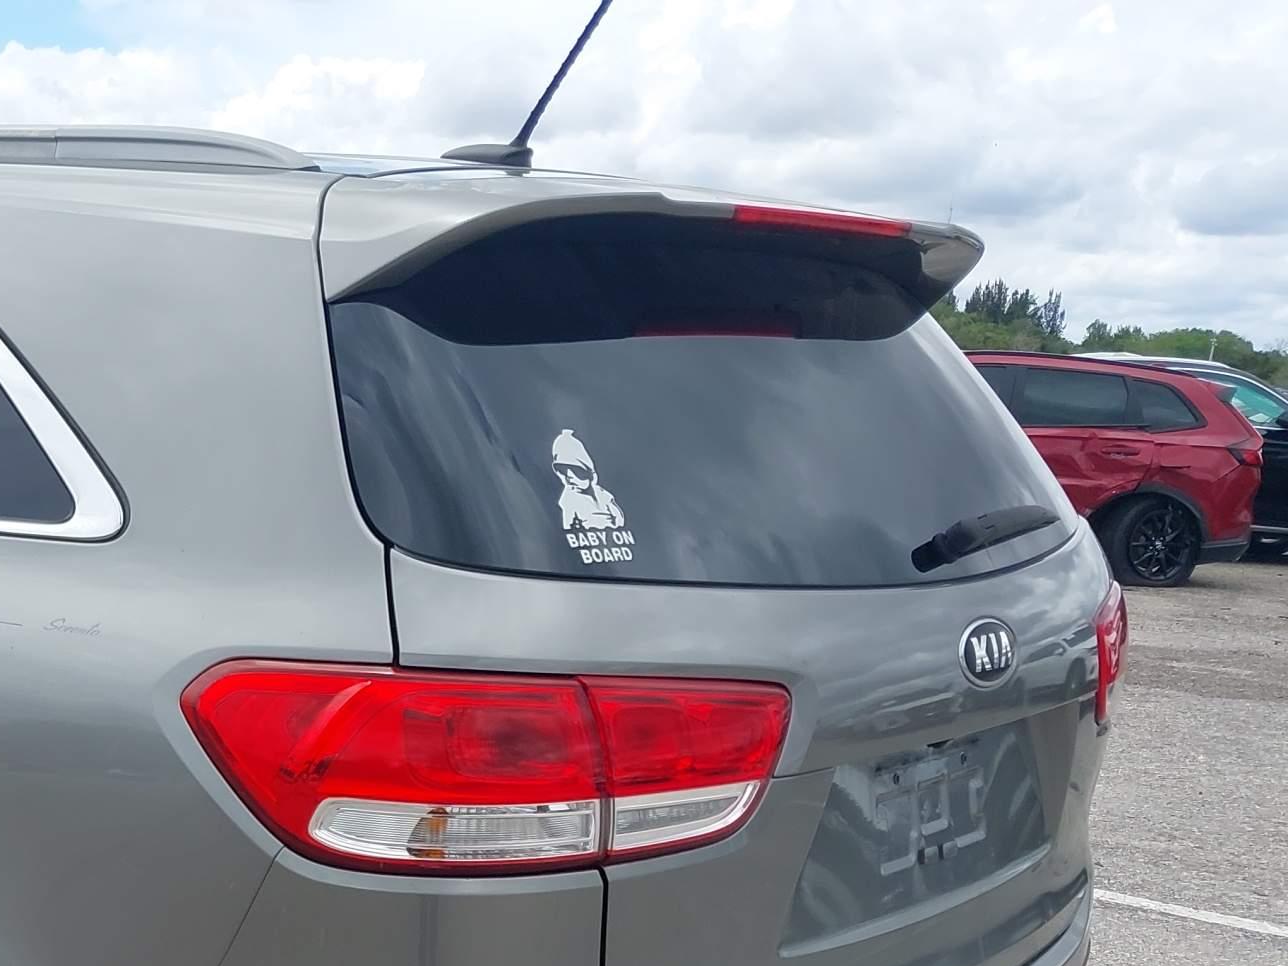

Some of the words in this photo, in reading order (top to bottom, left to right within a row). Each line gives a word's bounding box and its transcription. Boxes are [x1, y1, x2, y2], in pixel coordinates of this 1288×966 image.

[566, 531, 608, 548] BABY
[612, 530, 635, 545] ON
[579, 547, 633, 564] BOARD
[970, 631, 1012, 673] KIA
